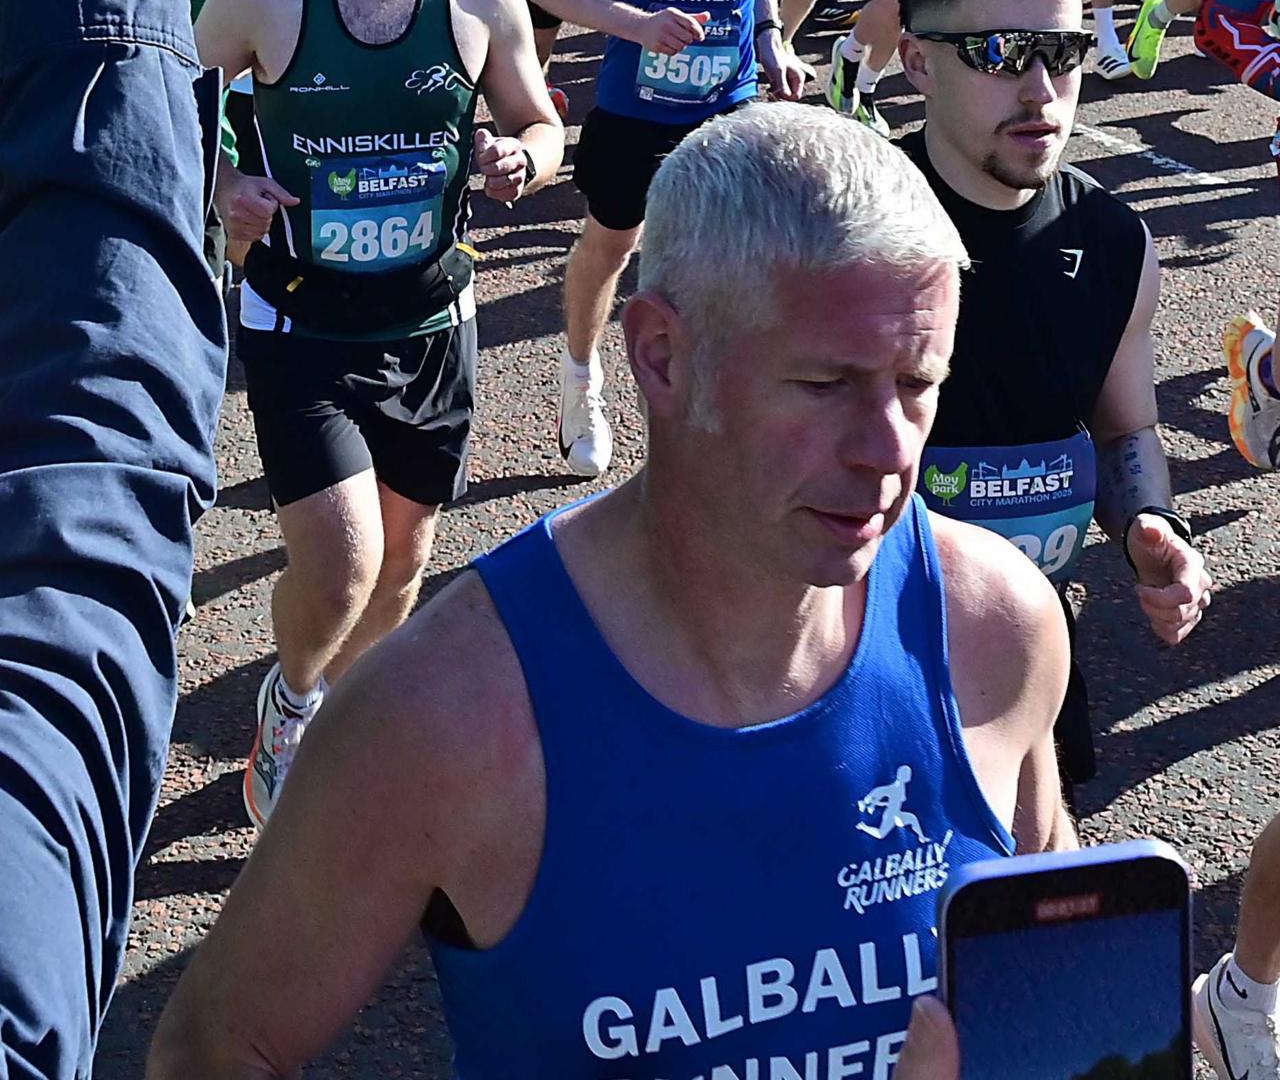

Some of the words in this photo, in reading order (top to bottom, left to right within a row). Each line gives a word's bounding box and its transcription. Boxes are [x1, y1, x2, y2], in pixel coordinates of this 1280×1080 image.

[644, 51, 731, 86] 3505
[289, 85, 351, 93] RONHILL
[293, 127, 460, 155] ENNISKILLEN
[358, 175, 428, 193] BELFAST
[320, 210, 434, 262] 2864
[932, 474, 959, 485] Moy
[932, 484, 960, 494] park
[970, 471, 1073, 498] BELFAST
[970, 499, 992, 507] CITY
[996, 494, 1051, 506] MARATHON
[1053, 489, 1073, 500] 2025
[837, 829, 953, 887] GALBALLY
[843, 862, 949, 914] RUNNERS
[583, 930, 938, 1059] GALBALL
